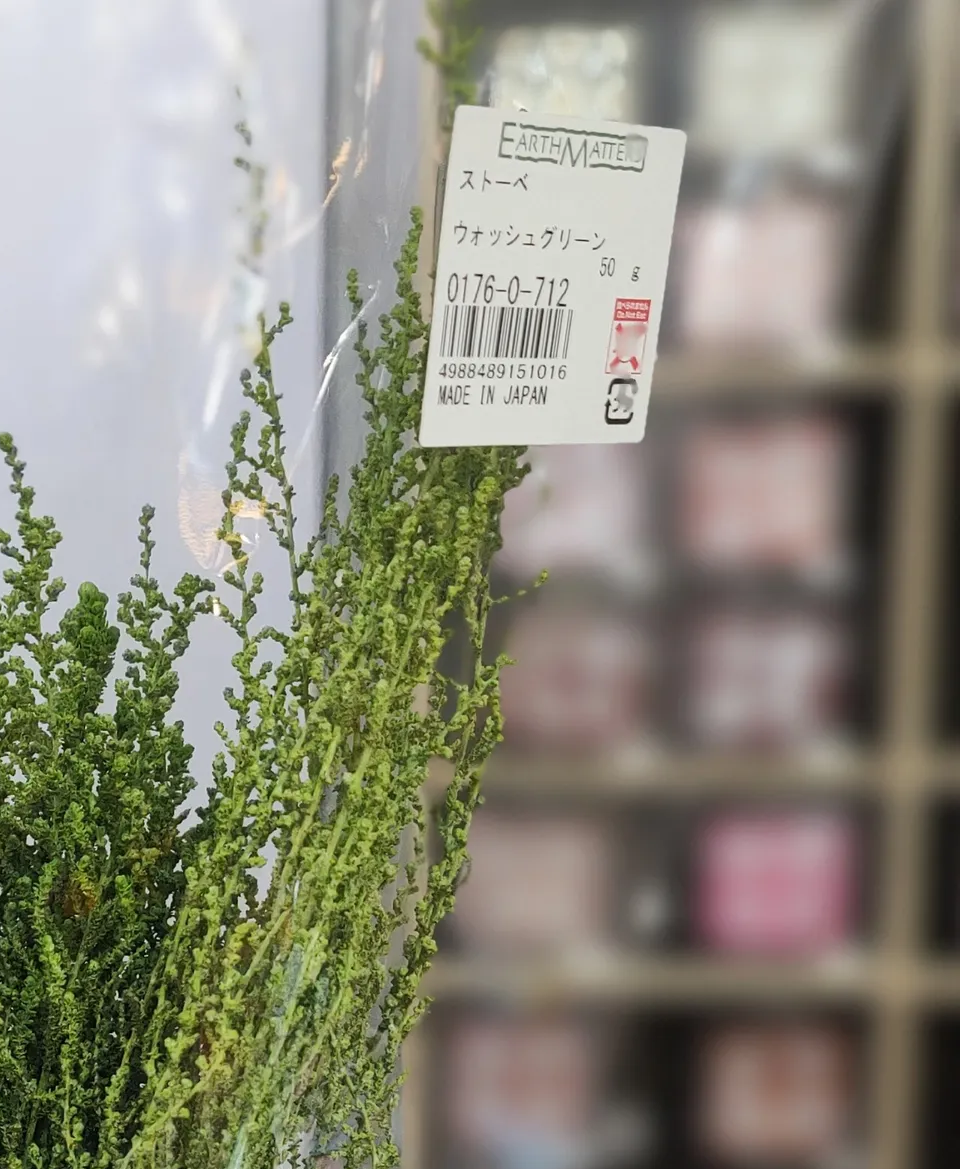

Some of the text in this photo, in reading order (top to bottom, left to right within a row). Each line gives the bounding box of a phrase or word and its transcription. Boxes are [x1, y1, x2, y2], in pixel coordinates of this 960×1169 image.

[460, 170, 528, 191] ストーベ
[454, 220, 606, 251] ウォッシュグリーン
[599, 257, 641, 282] 50 g
[447, 273, 570, 308] 0176-0-712
[439, 362, 567, 380] 4988489151016
[438, 384, 548, 405] MADE IN JAPAN
